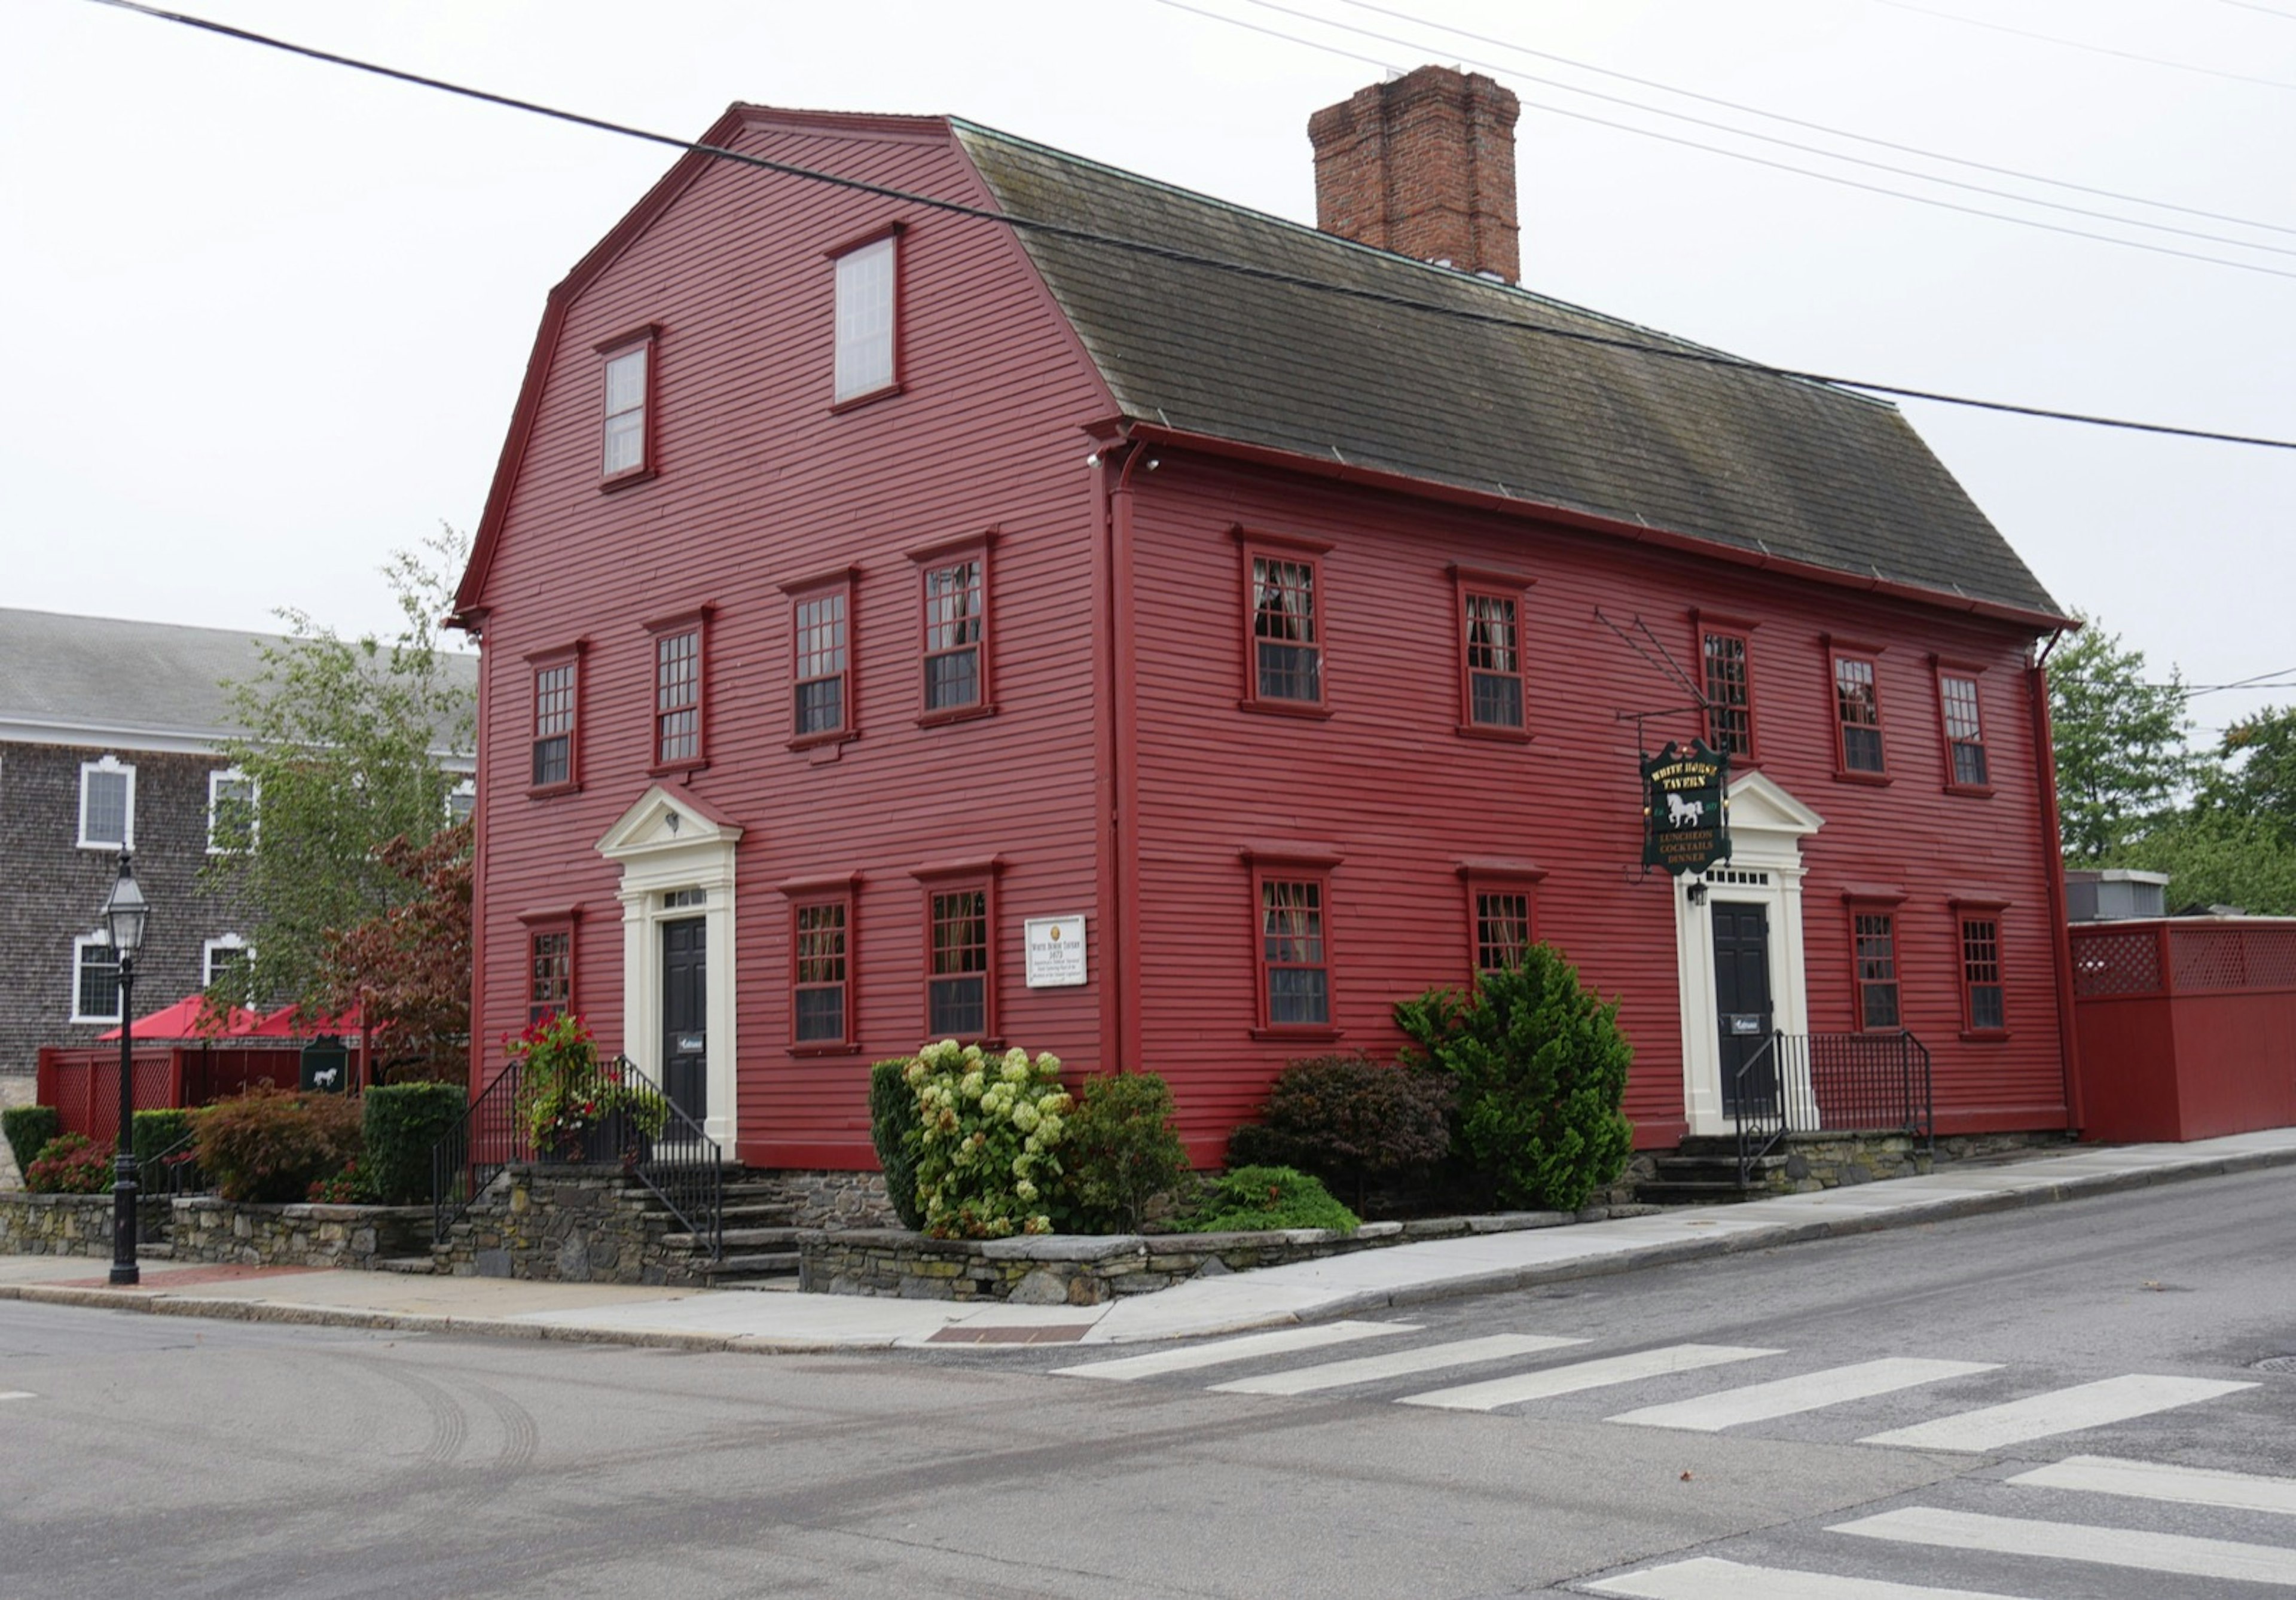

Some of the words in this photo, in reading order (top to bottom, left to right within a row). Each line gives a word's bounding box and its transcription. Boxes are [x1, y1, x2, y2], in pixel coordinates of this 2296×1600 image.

[1651, 763, 1683, 781] WHITE
[1685, 762, 1717, 776] HORSE
[1663, 775, 1705, 790] TAVERN
[1660, 830, 1712, 842] LUNCHEON
[1660, 842, 1713, 854] COCKTAILS
[1668, 853, 1705, 863] DINNER
